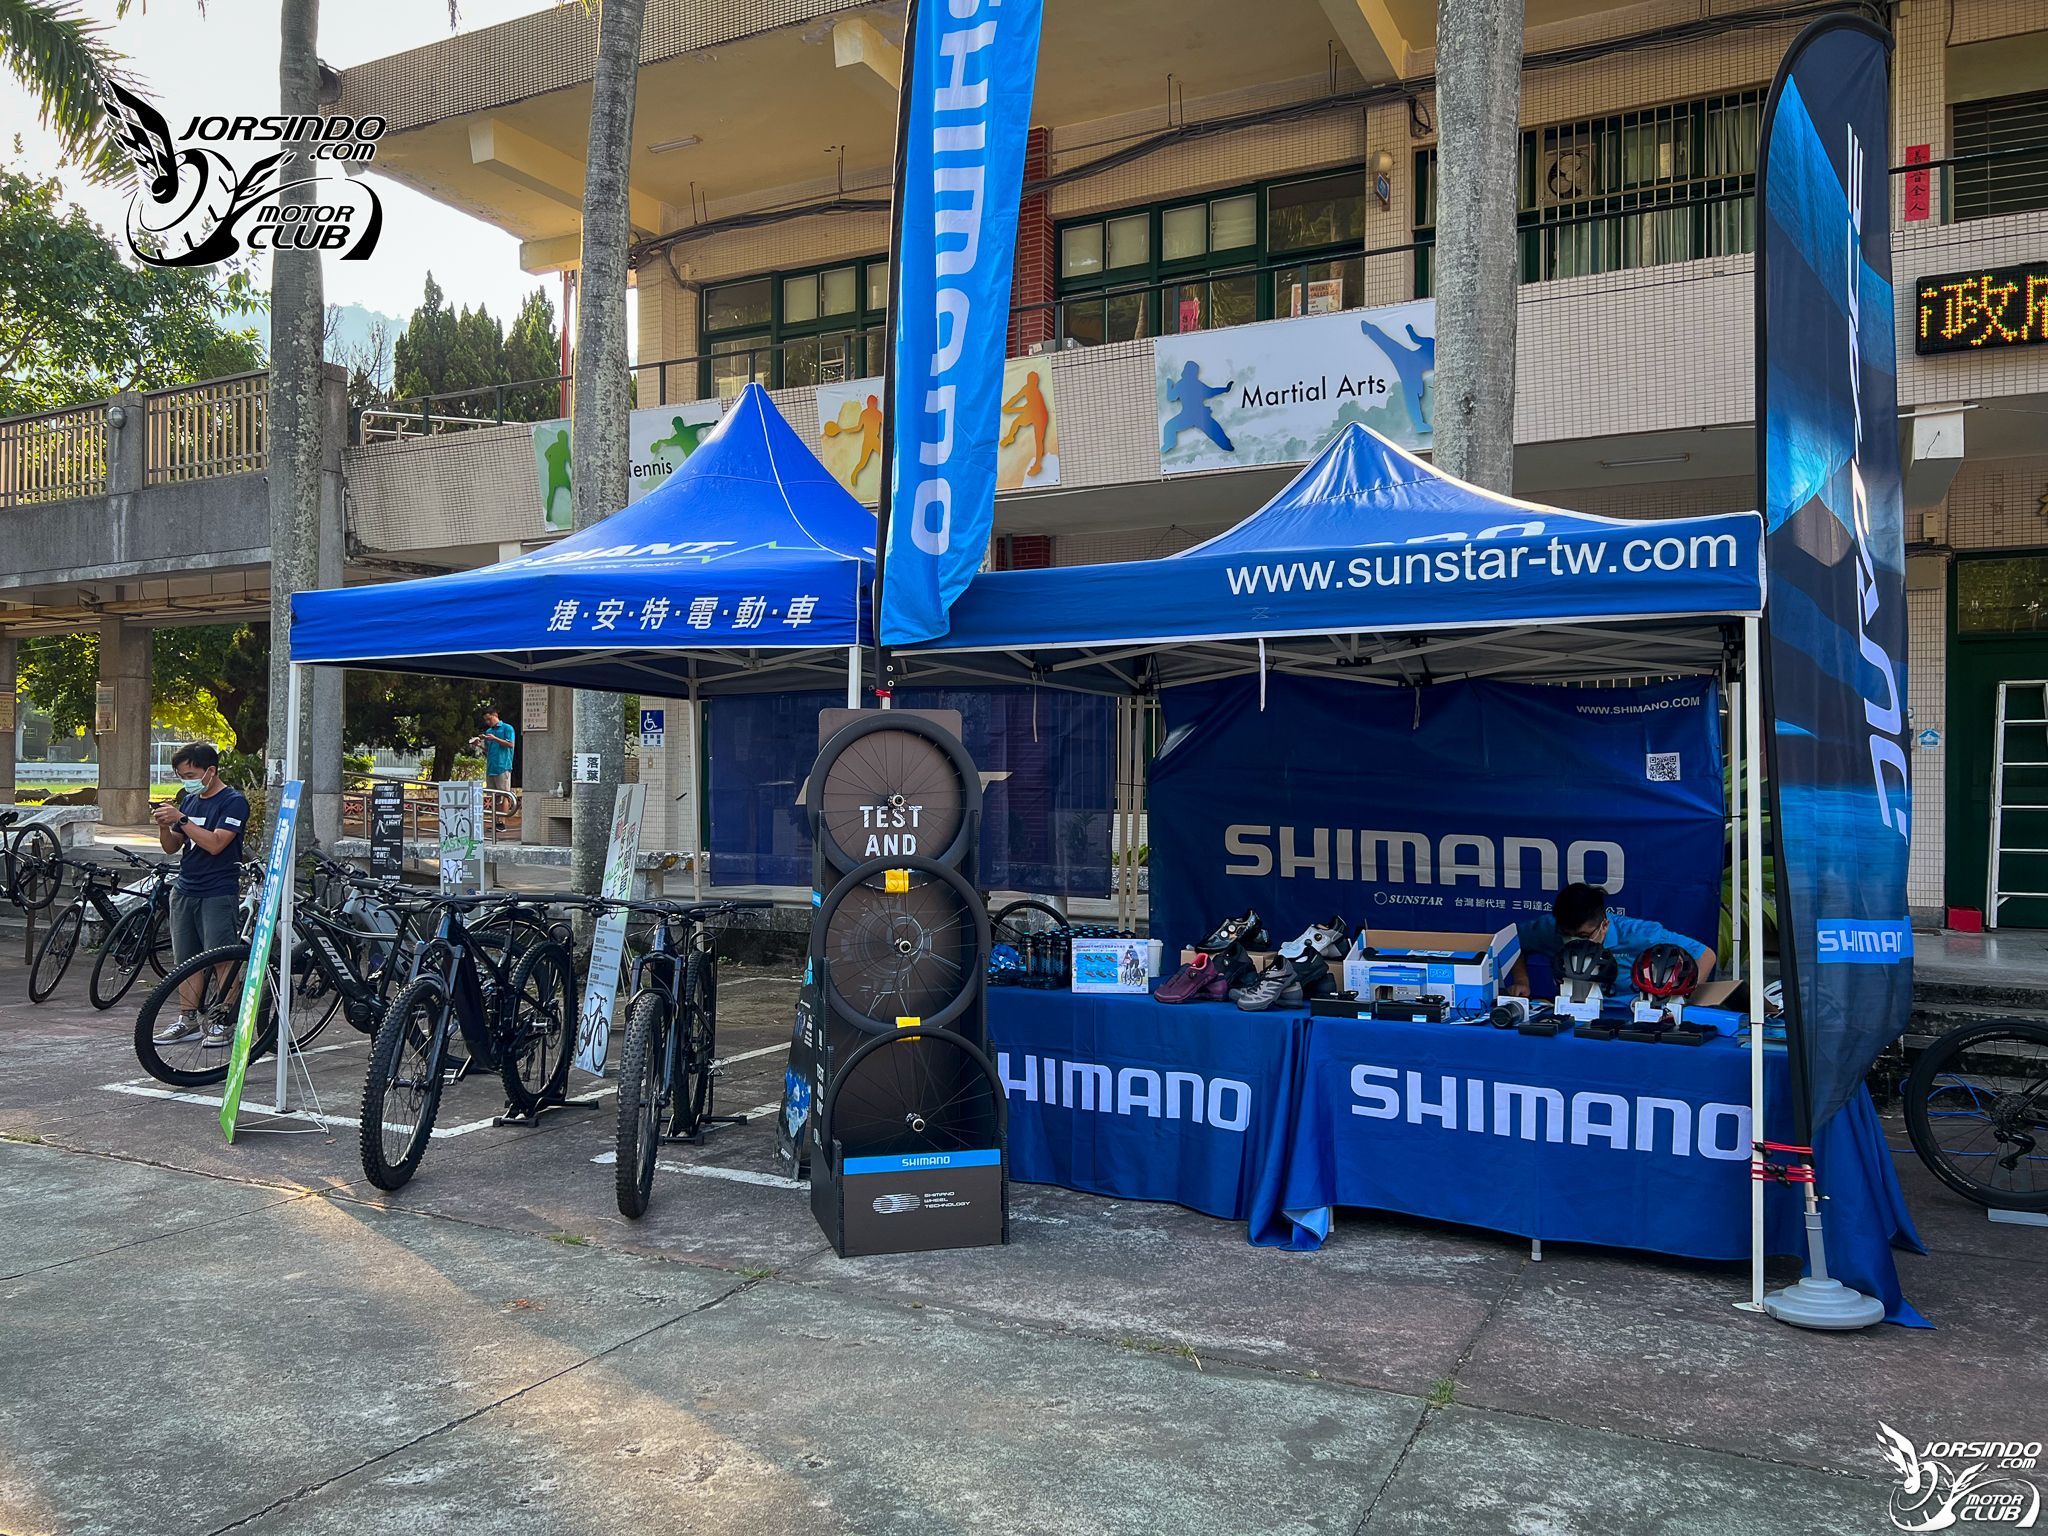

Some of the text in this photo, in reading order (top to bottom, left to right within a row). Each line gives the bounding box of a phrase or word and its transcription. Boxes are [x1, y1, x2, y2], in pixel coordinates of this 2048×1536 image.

[1241, 374, 1386, 409] Martial Arts
[1226, 534, 1738, 596] www.sunstar-tw.com
[1576, 696, 1700, 714] WWW.SHIMANO.COM
[859, 805, 923, 828] TEST
[864, 833, 917, 857] AND
[1225, 824, 1625, 896] SHIMANO
[1389, 894, 1444, 906] SUNSTAR
[317, 936, 356, 984] GIANT
[1350, 1064, 1753, 1161] SHIMANO
[901, 1155, 951, 1167] SHIMANO
[924, 1201, 971, 1209] TECHNOLOGY
